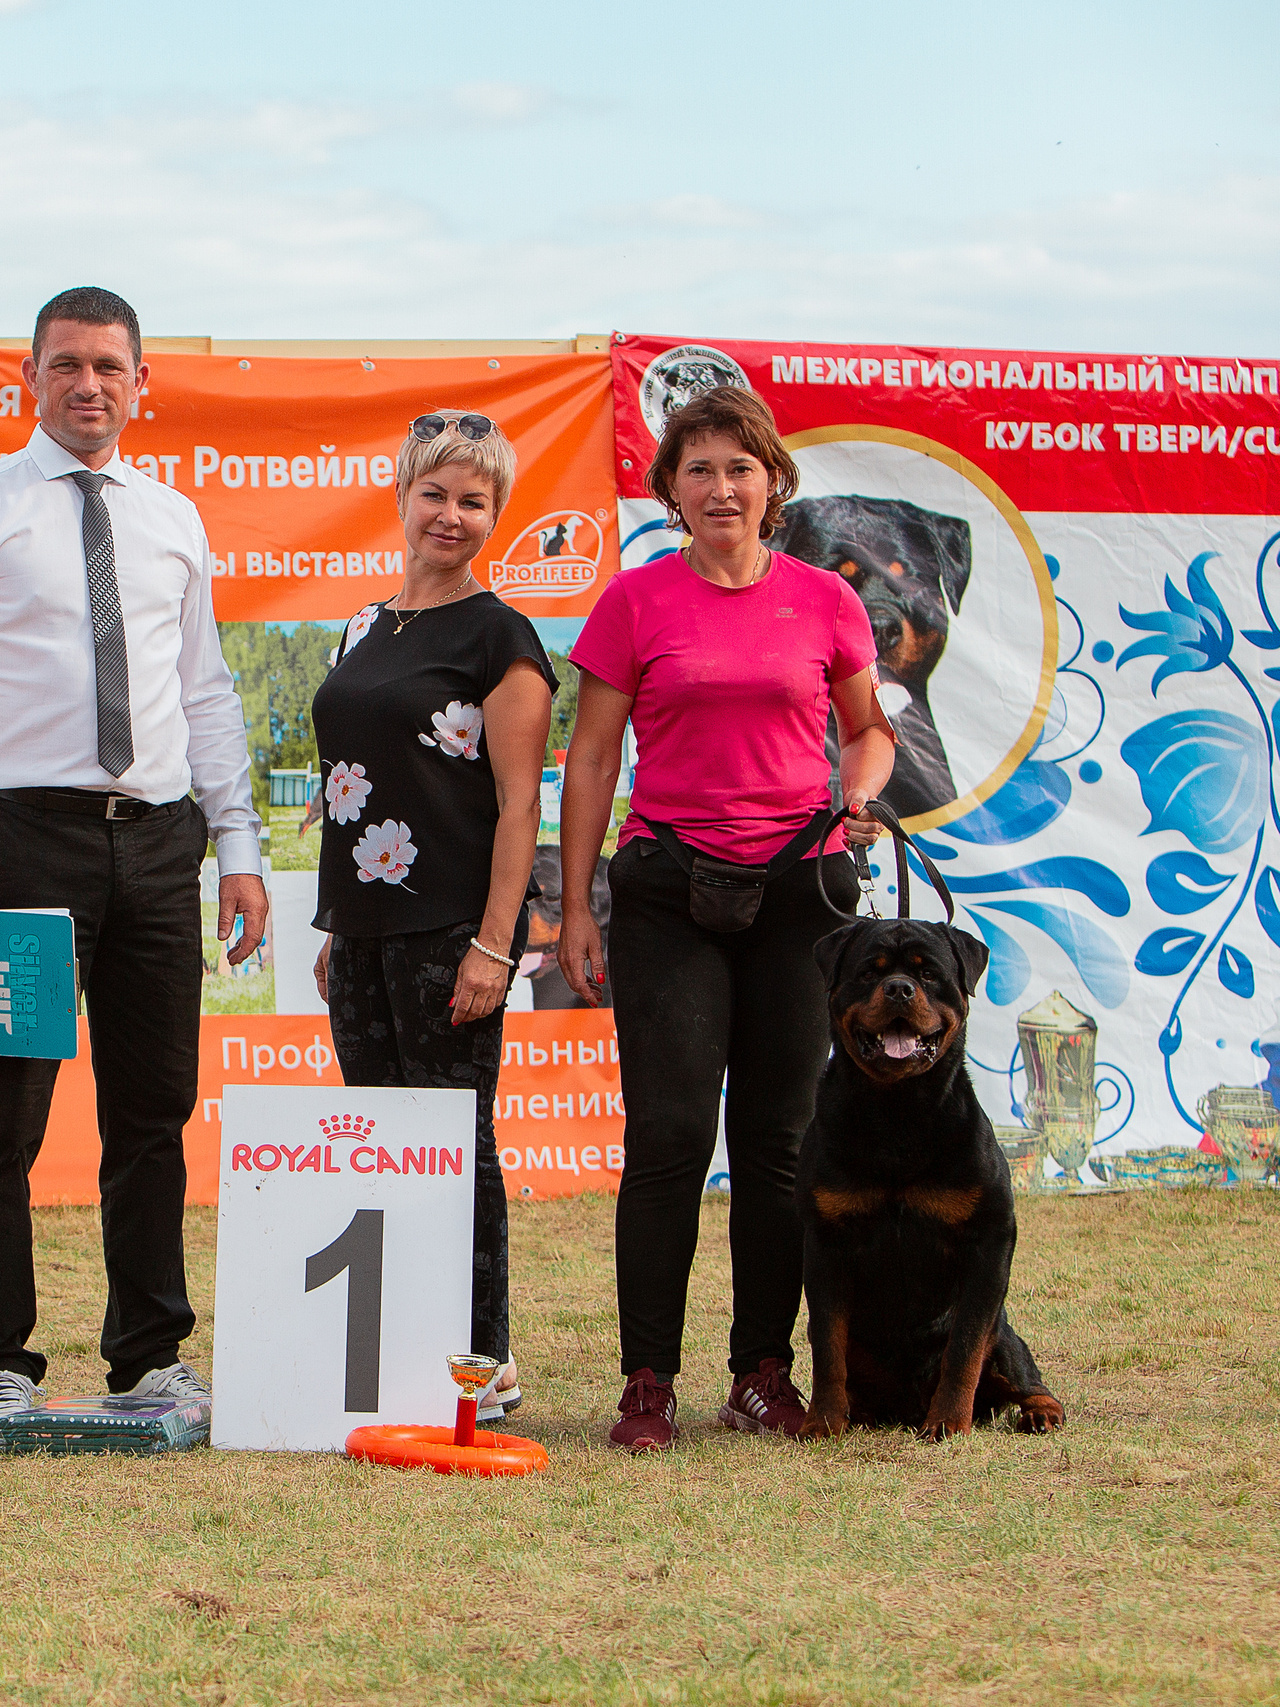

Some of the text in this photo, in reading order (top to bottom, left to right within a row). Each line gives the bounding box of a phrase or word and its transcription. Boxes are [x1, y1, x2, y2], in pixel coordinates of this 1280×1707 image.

[771, 355, 1165, 393] МЕЖРЕГИОНАЛЬНЫЙ
[1174, 363, 1279, 395] ЧЕМП
[985, 421, 1280, 458] КУБОК ТВЕРИ/CU
[194, 444, 398, 488] Ротвейле
[246, 551, 404, 577] выставки
[232, 1143, 462, 1175] ROYAL CANIN
[305, 1209, 384, 1412] 1
